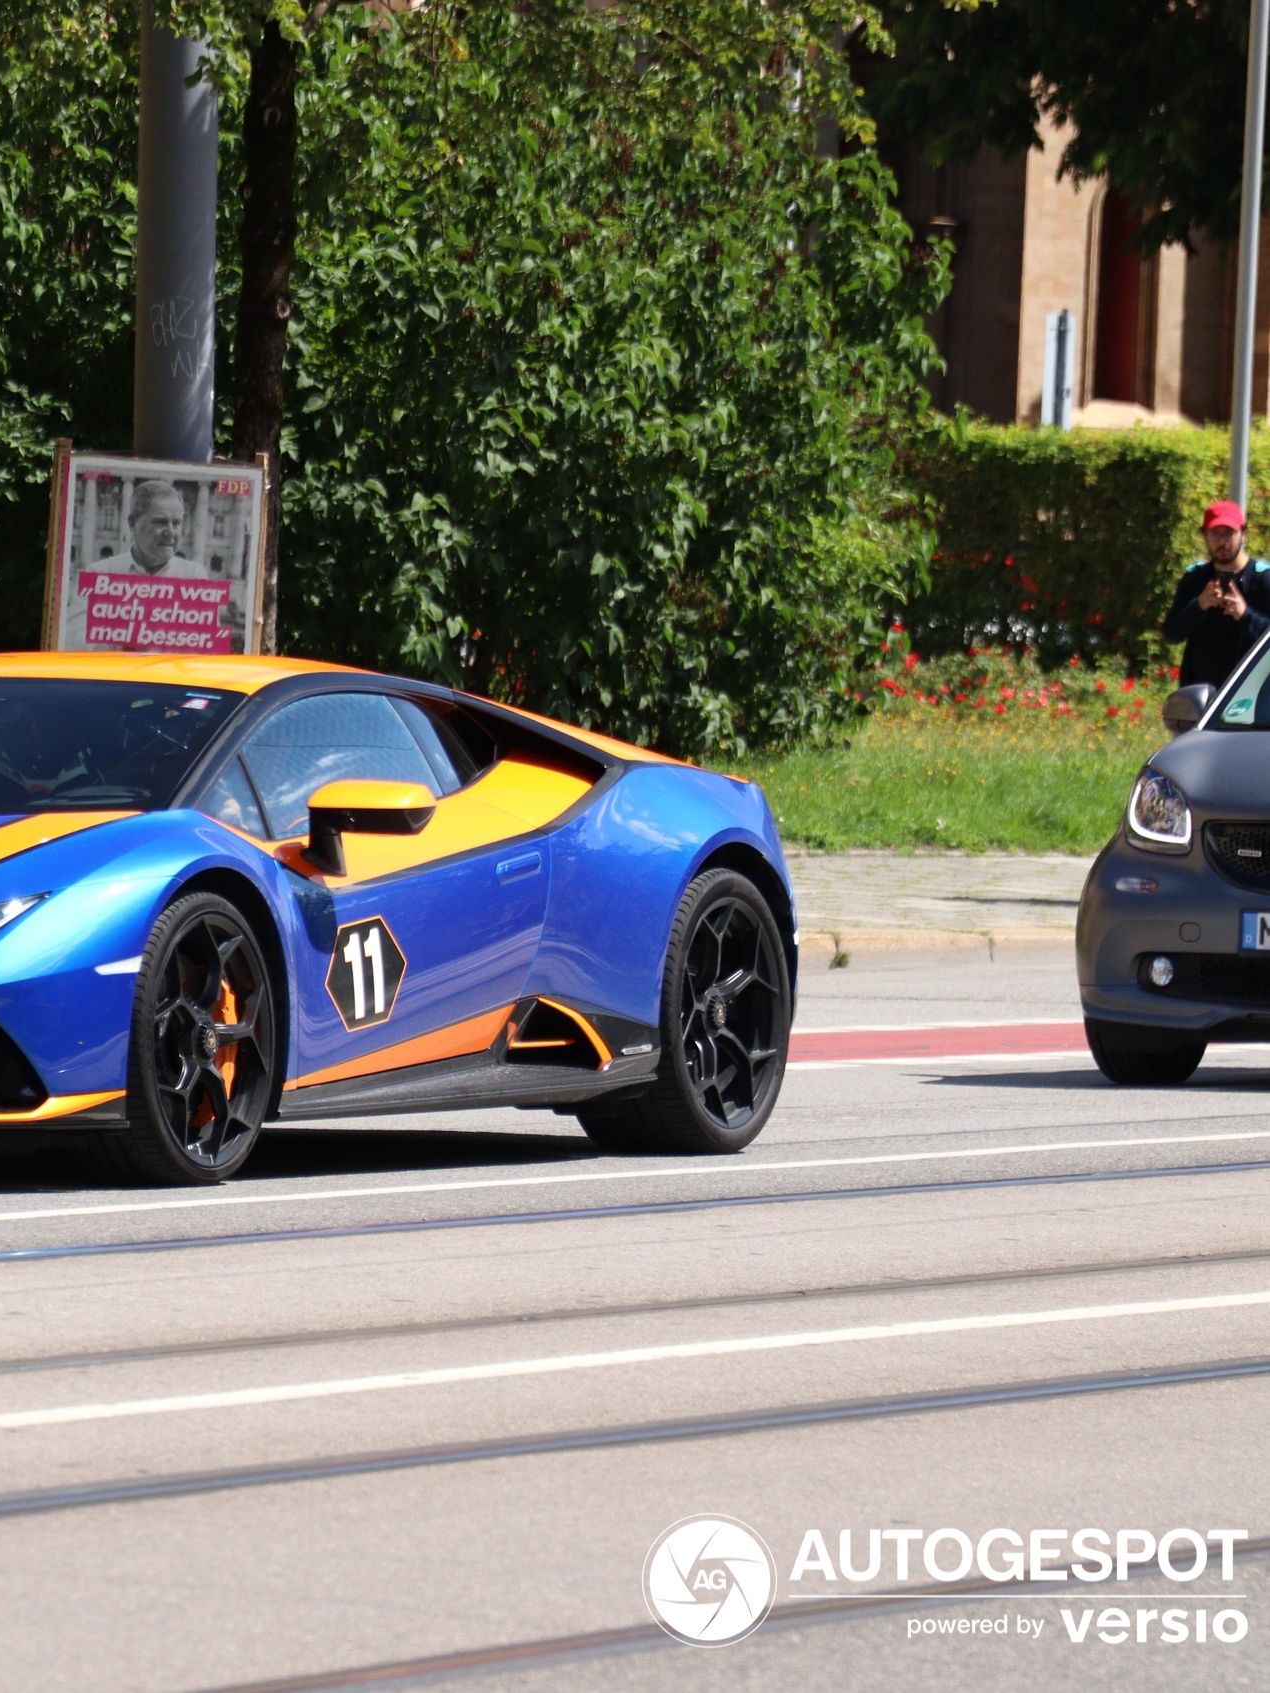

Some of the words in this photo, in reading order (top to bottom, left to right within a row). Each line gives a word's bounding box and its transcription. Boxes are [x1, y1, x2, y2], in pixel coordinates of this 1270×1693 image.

[217, 480, 250, 494] FDP
[180, 585, 226, 603] war
[92, 599, 145, 621] auch
[150, 601, 214, 625] schon
[90, 621, 135, 643] mal
[1245, 934, 1252, 944] D
[343, 927, 385, 1020] 11
